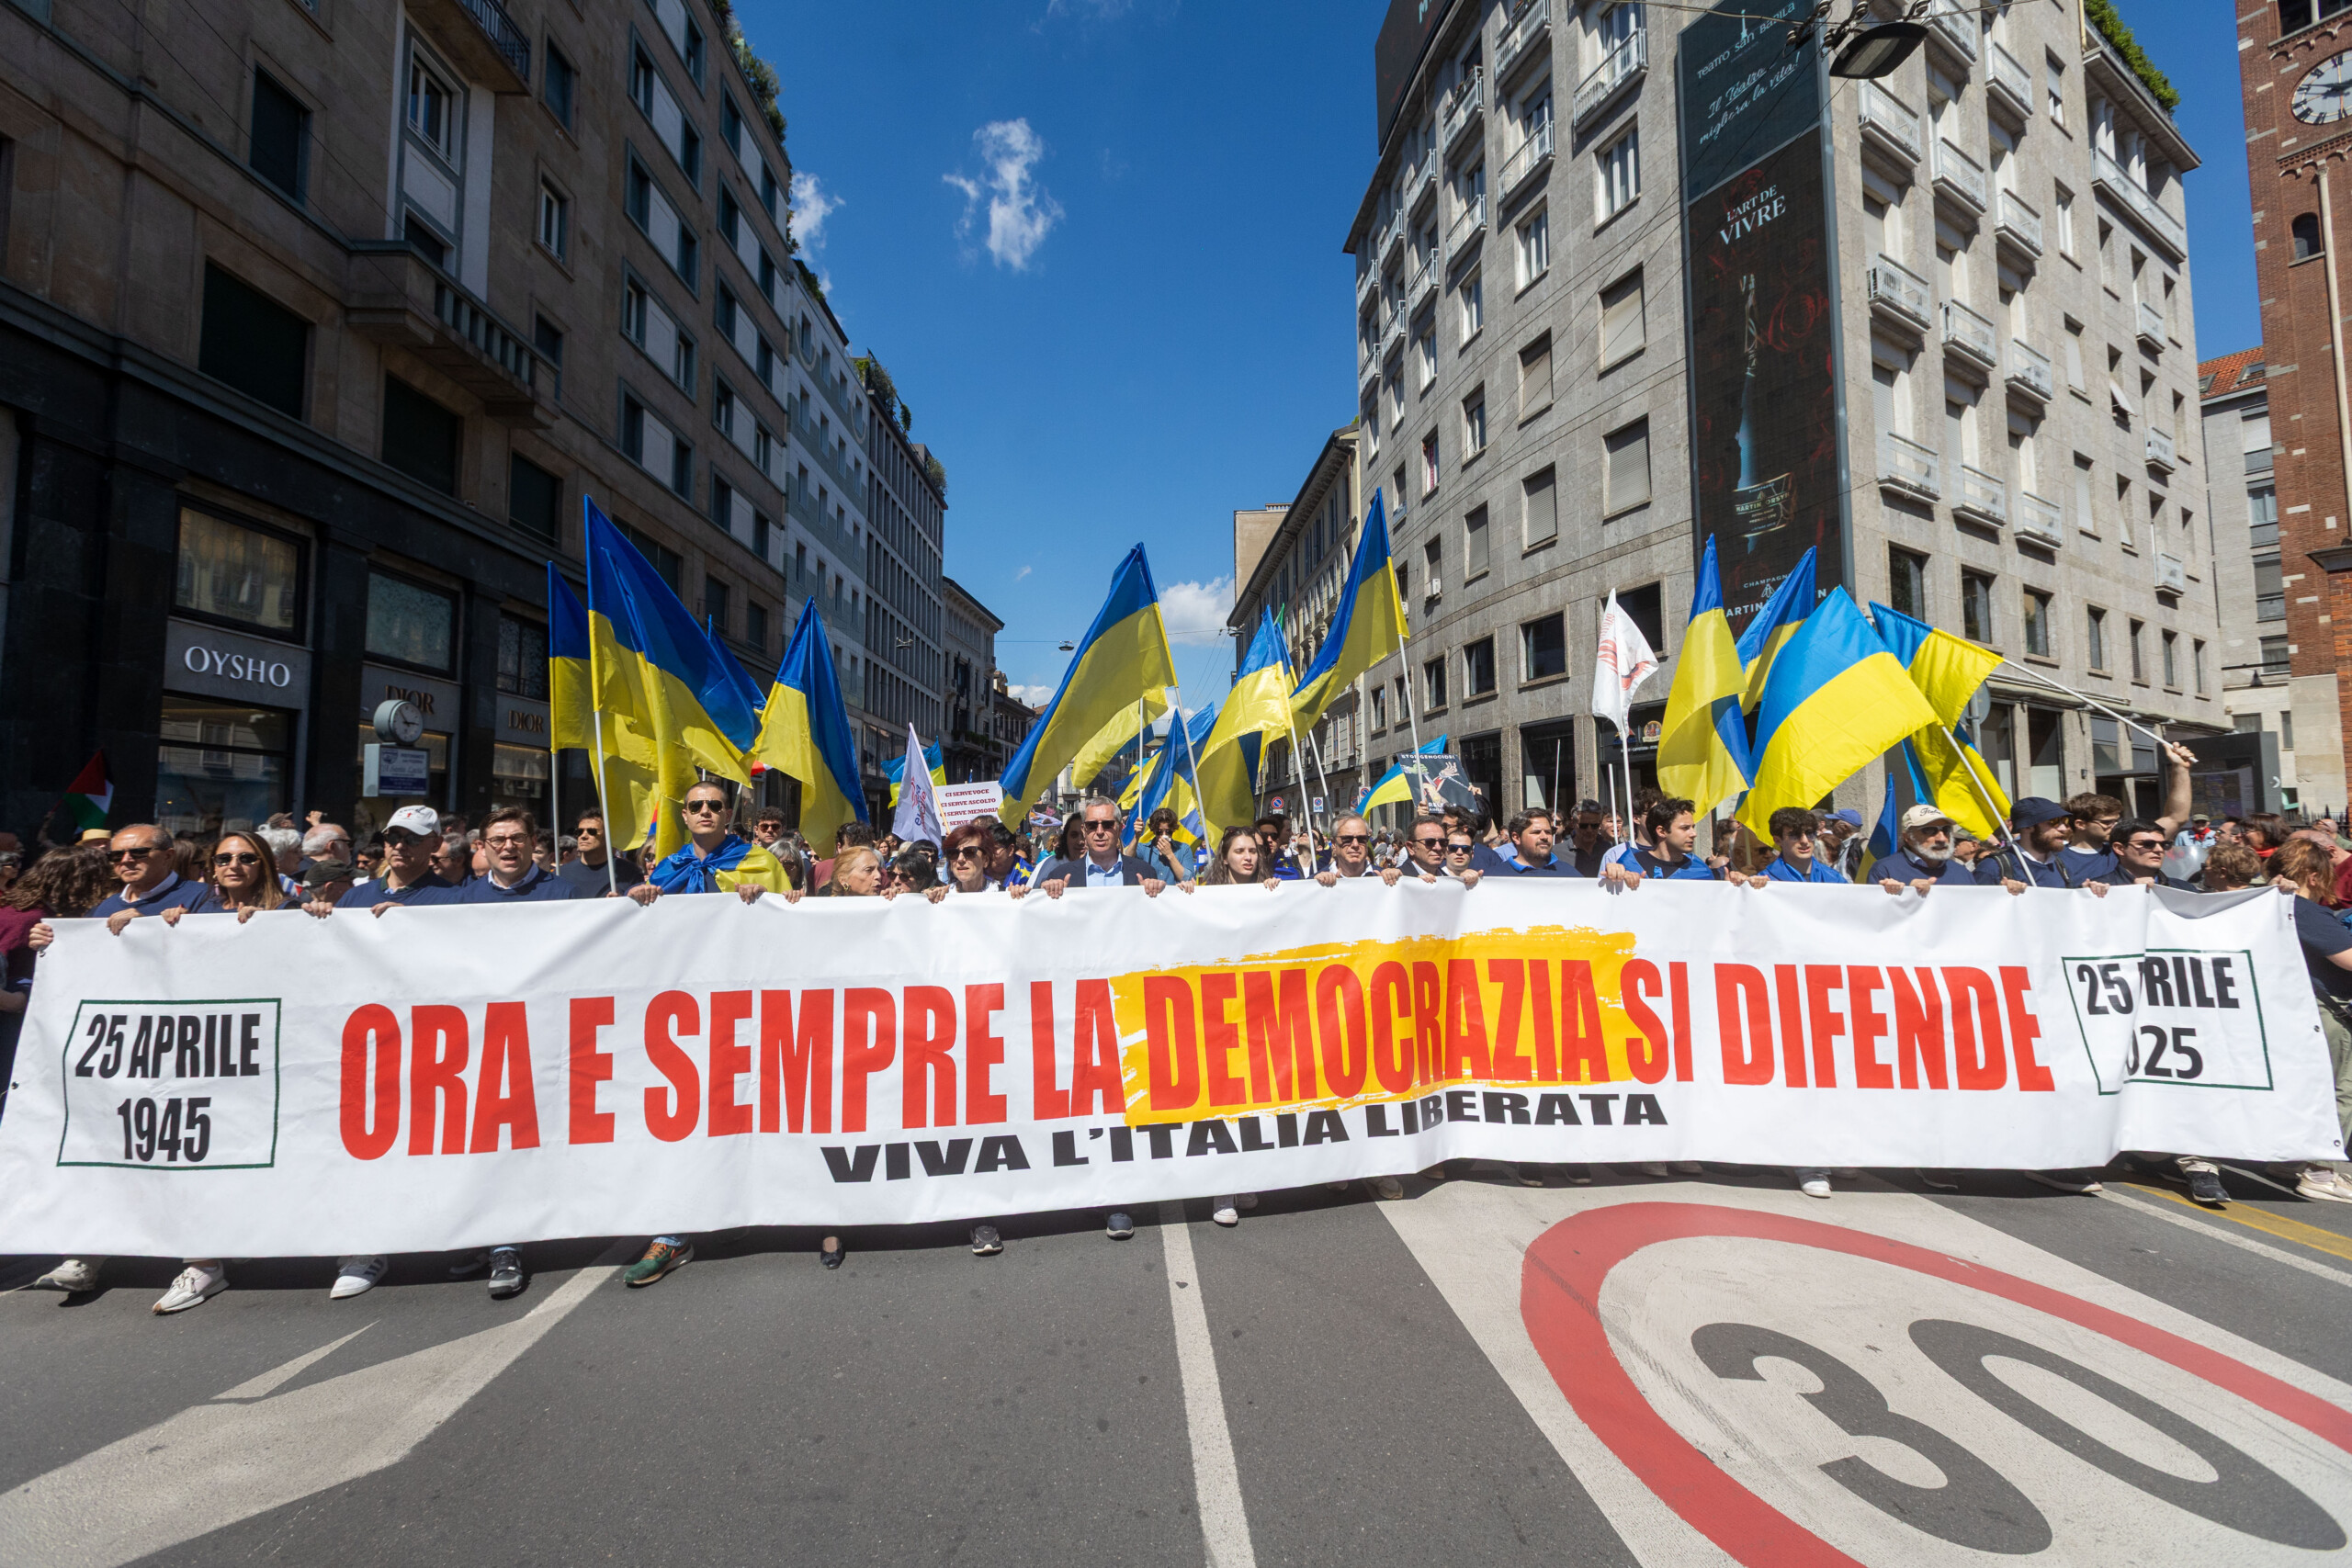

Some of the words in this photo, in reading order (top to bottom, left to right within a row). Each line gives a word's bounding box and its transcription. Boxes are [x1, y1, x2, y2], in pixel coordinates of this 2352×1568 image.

[1752, 84, 1769, 101] la
[1720, 195, 1786, 245] VIVRE
[1727, 195, 1758, 222] L'ART
[1759, 185, 1777, 203] DE
[1743, 573, 1791, 589] CHAMPAGN
[1725, 602, 1764, 618] ARTIN
[185, 646, 290, 687] OYSHO
[508, 709, 544, 733] DIOR
[2076, 963, 2133, 1015] 25
[74, 1013, 127, 1079] 25
[130, 1013, 261, 1079] APRILE
[340, 1001, 540, 1160] ORA
[569, 996, 615, 1145] E
[643, 982, 1007, 1143] SEMPRE
[1030, 978, 1126, 1121] LA
[1143, 958, 1611, 1111] DEMOCRAZIA
[1620, 958, 1694, 1085] SI
[1714, 963, 2055, 1092] DIFENDE
[117, 1097, 211, 1162] 1945
[820, 1134, 1031, 1183] VIVA
[1052, 1110, 1349, 1168] L'ITALIA
[1365, 1090, 1668, 1138] LIBERATA
[1690, 1319, 2348, 1555] 30
